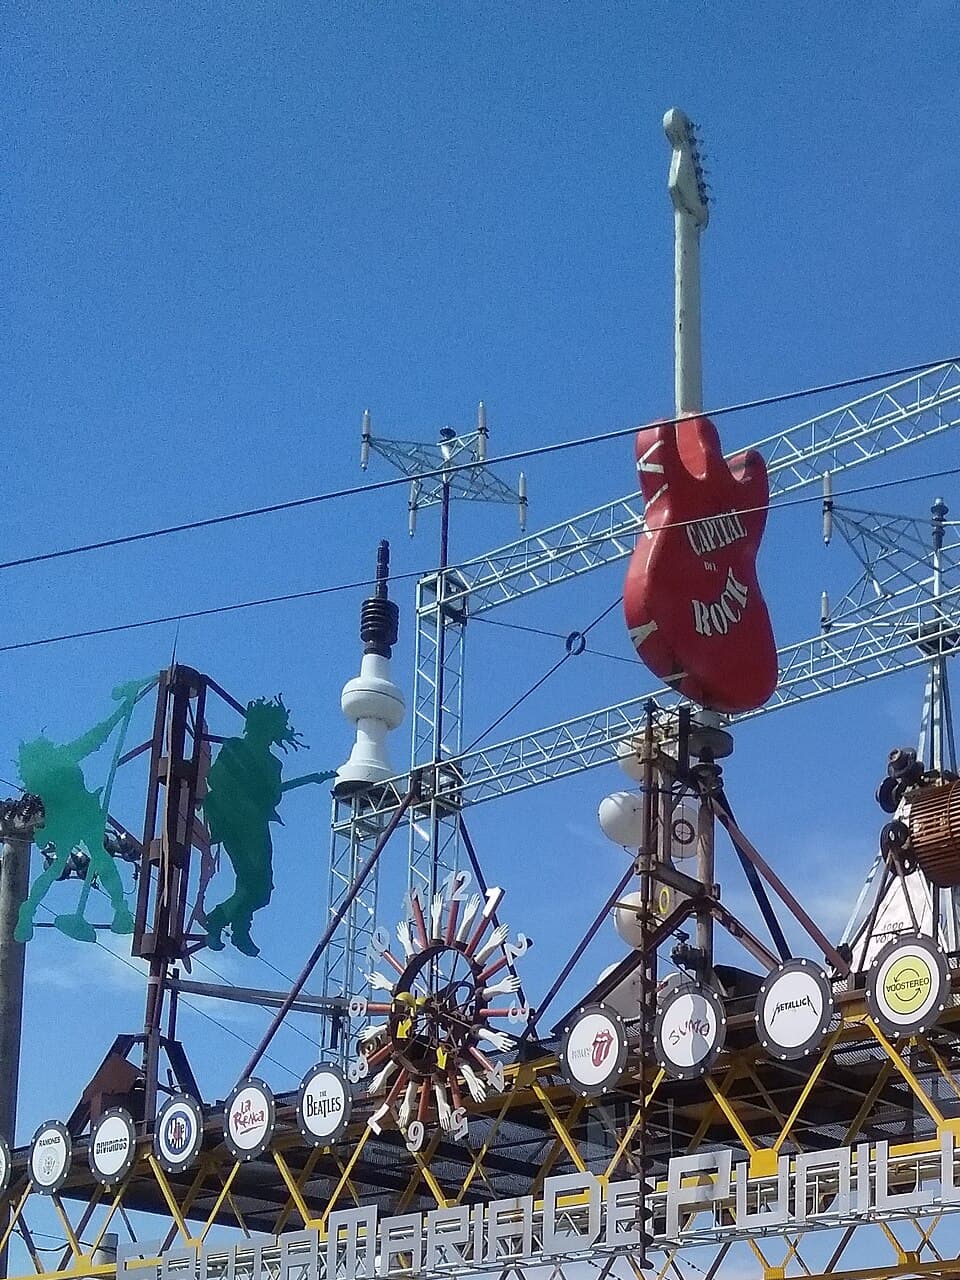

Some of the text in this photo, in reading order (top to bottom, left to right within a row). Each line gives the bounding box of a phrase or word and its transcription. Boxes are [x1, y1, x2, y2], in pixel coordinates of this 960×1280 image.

[691, 566, 748, 636] ROCK
[770, 995, 818, 1026] METALLICA
[306, 1094, 341, 1117] BEATLES
[38, 1136, 61, 1148] RAMONES
